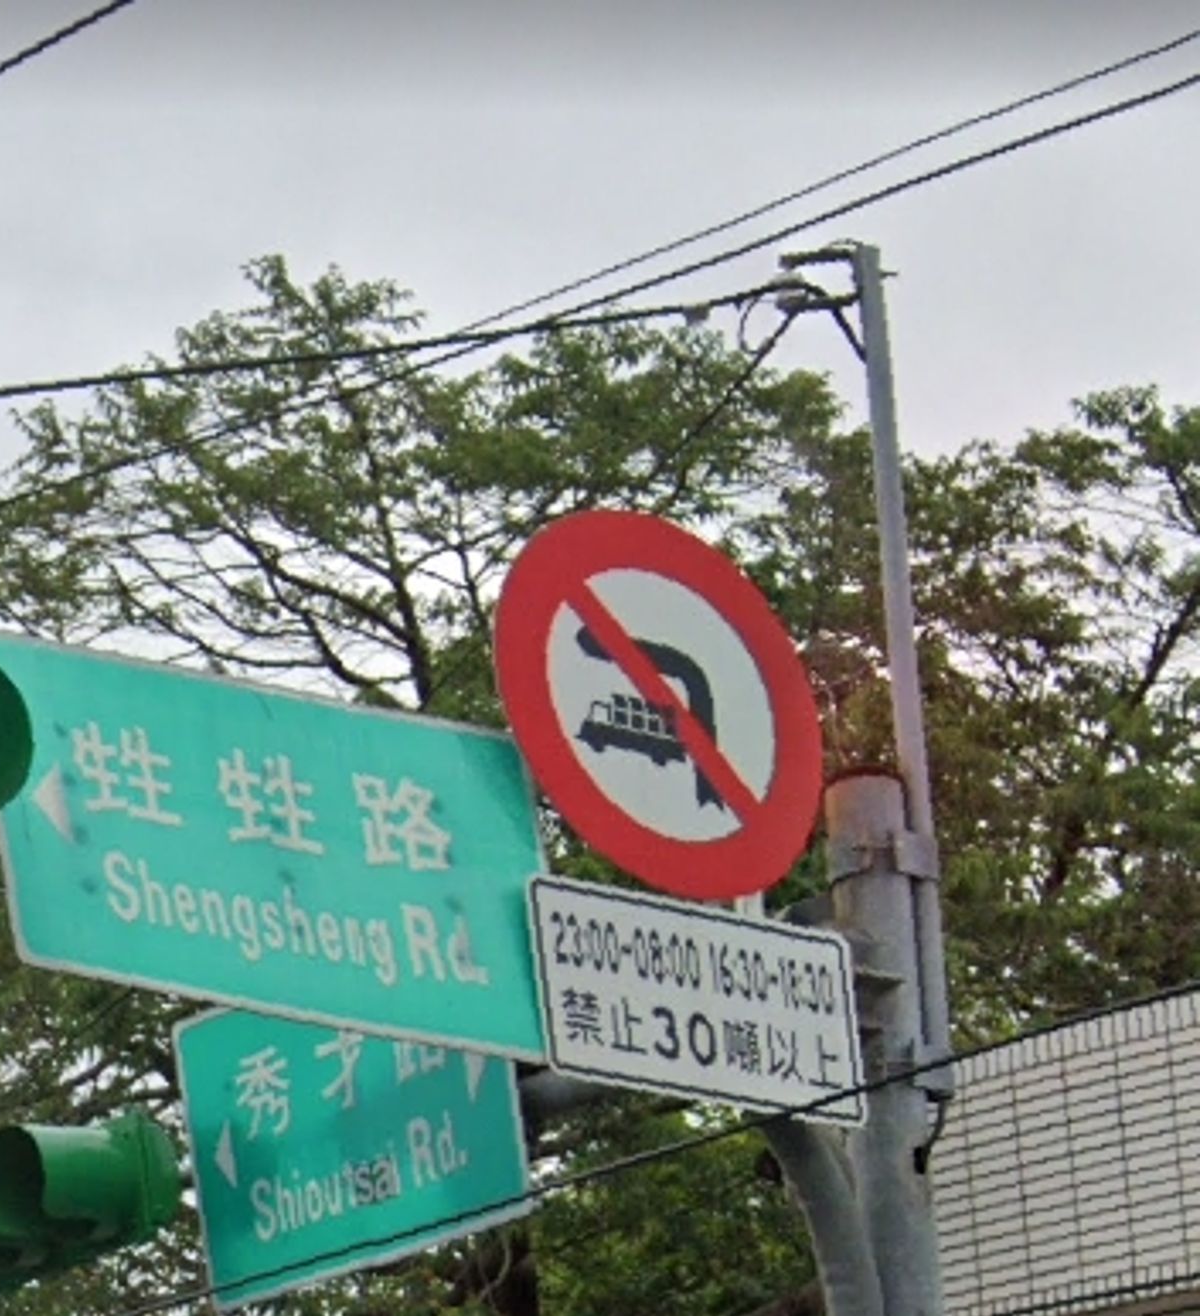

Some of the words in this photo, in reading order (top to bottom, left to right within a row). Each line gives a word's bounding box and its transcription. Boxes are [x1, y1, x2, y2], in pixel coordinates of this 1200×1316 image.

[71, 721, 453, 872] 甡甡路
[102, 850, 398, 986] Shengsheng
[402, 904, 490, 986] Rd.
[550, 910, 700, 989] 23:00-08:00
[560, 987, 843, 1090] 禁止30噸以上
[249, 1141, 402, 1243] Shioutsai
[407, 1110, 469, 1189] Rd.
